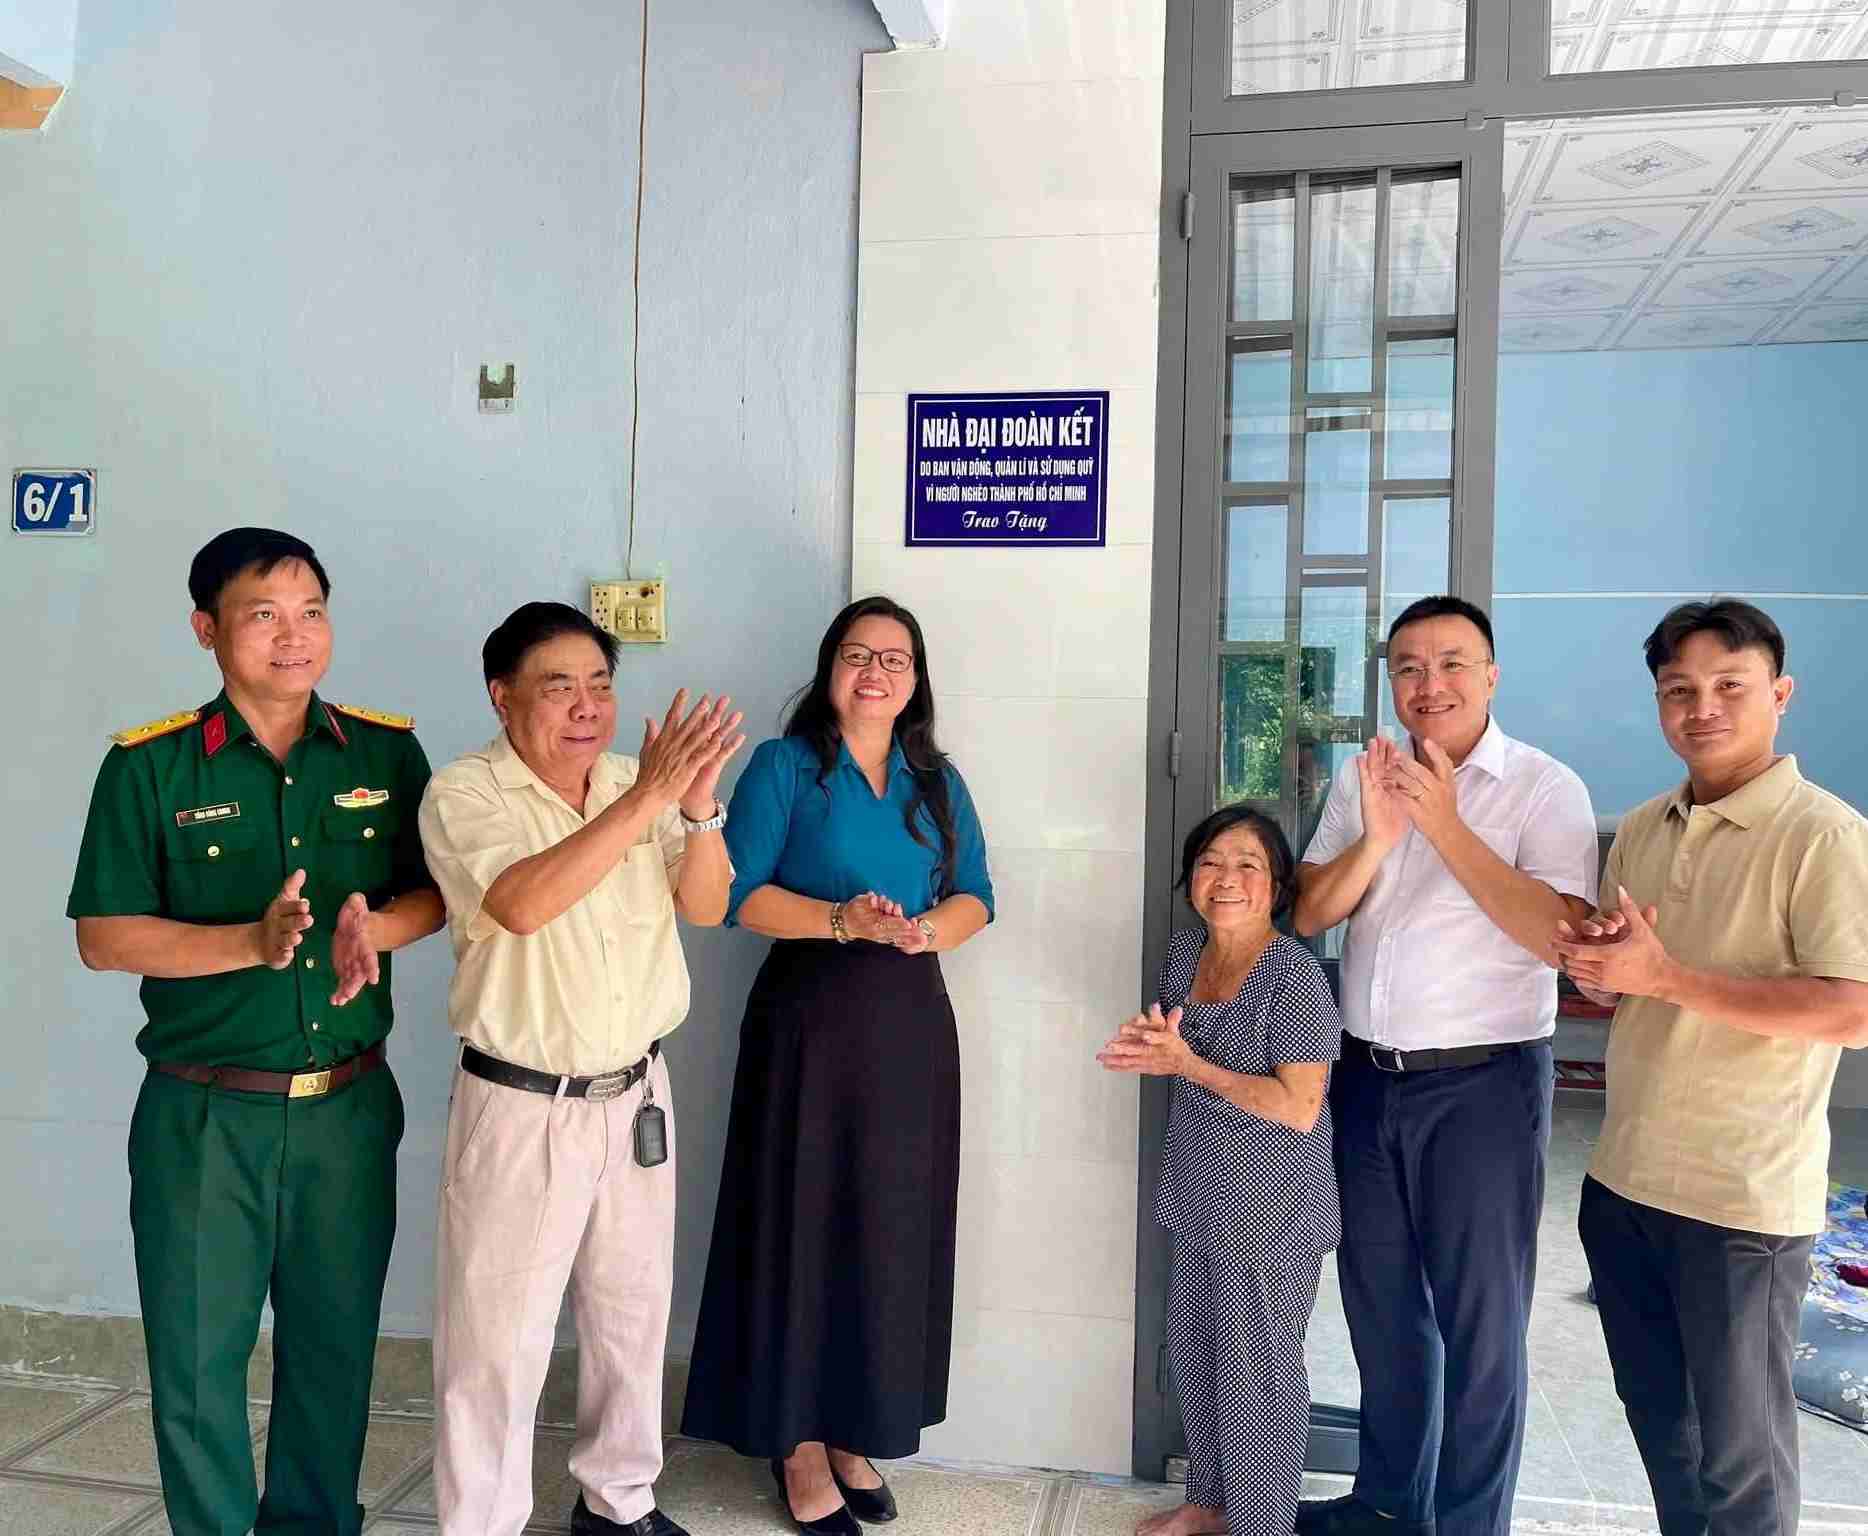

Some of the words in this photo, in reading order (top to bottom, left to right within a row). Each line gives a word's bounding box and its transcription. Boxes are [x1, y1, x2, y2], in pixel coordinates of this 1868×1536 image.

[922, 411, 960, 448] NHÀ
[965, 417, 996, 454] ĐẠI
[1001, 410, 1053, 447] ĐOÀN
[1058, 406, 1094, 446] KẾT
[920, 460, 931, 477] DO
[932, 460, 950, 477] BAN
[951, 457, 968, 480] VẬN
[994, 455, 1017, 478] QUẢN
[1027, 456, 1039, 476] VÀ
[1040, 455, 1053, 476] SỬ
[1053, 459, 1076, 479] DỤNG
[1077, 456, 1095, 477] QUỸ
[23, 482, 88, 522] 6/1
[935, 483, 960, 502] NGƯỜI
[961, 483, 988, 502] NGHÈO
[989, 482, 1016, 502] THÀNH
[1017, 480, 1035, 502] PHỐ
[1048, 482, 1063, 502] CHÍ
[1064, 485, 1087, 502] MINH
[962, 510, 999, 528] Trao
[1005, 510, 1048, 532] Tặng
